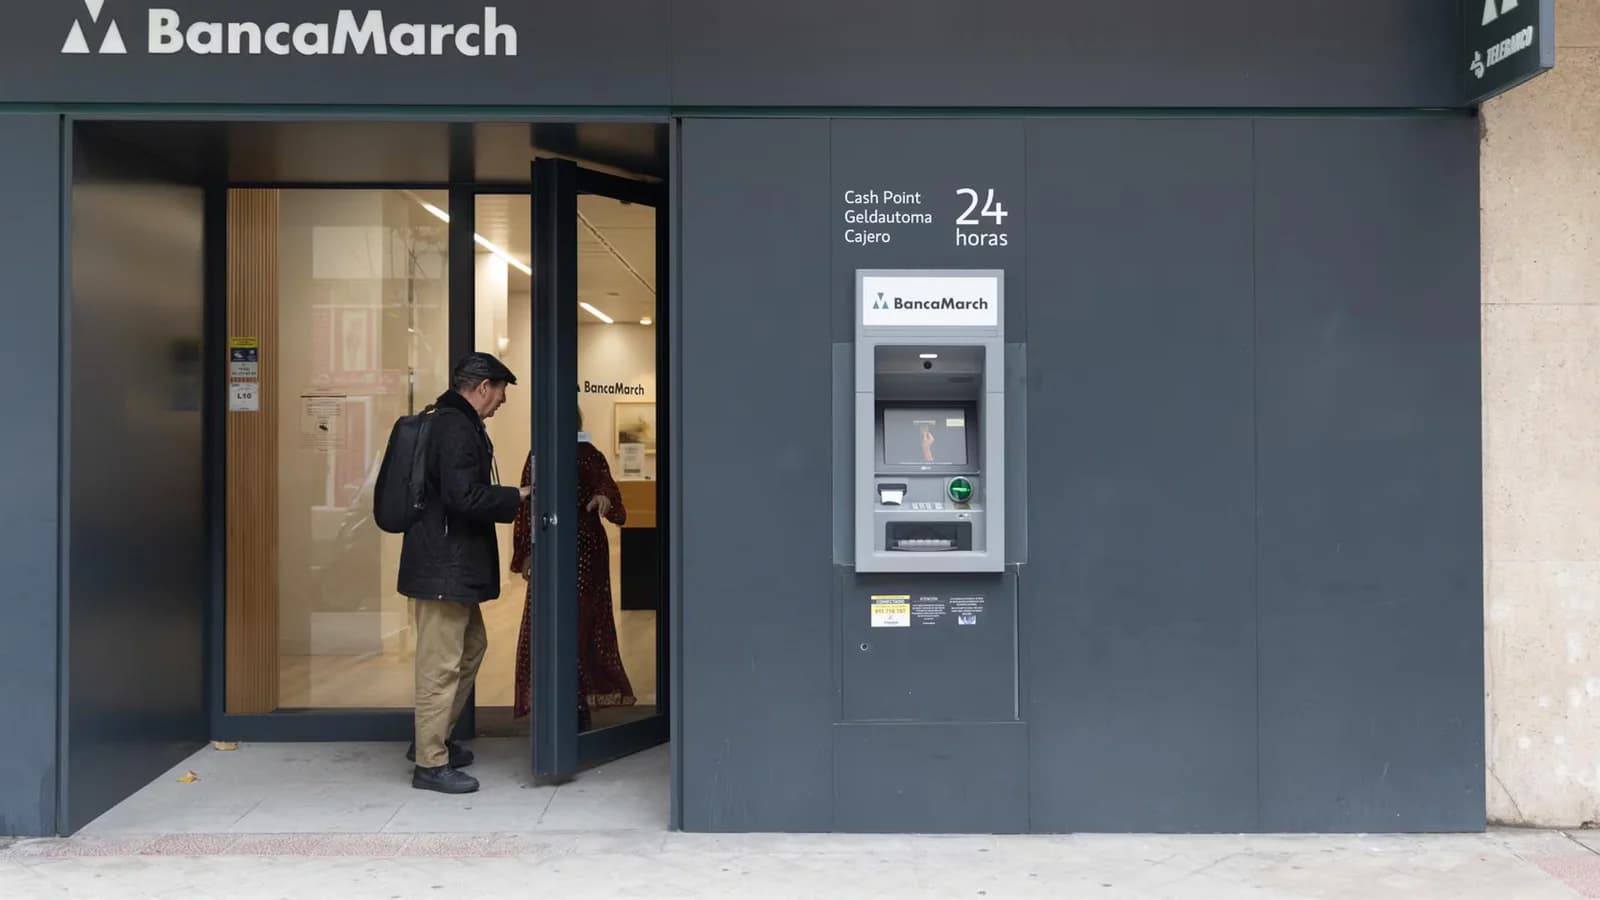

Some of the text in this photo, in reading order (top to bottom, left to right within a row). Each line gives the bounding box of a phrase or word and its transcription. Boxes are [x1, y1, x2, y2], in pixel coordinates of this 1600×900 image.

[148, 6, 517, 56] BancaMarch
[1486, 25, 1534, 67] TELEBANCO
[844, 190, 921, 204] Cash Point
[955, 187, 1009, 225] 24
[844, 209, 933, 224] Geldautoma
[844, 229, 891, 246] Cajero
[956, 227, 1008, 247] horas
[893, 297, 988, 310] BancaMarch
[584, 380, 645, 396] BancaMarch
